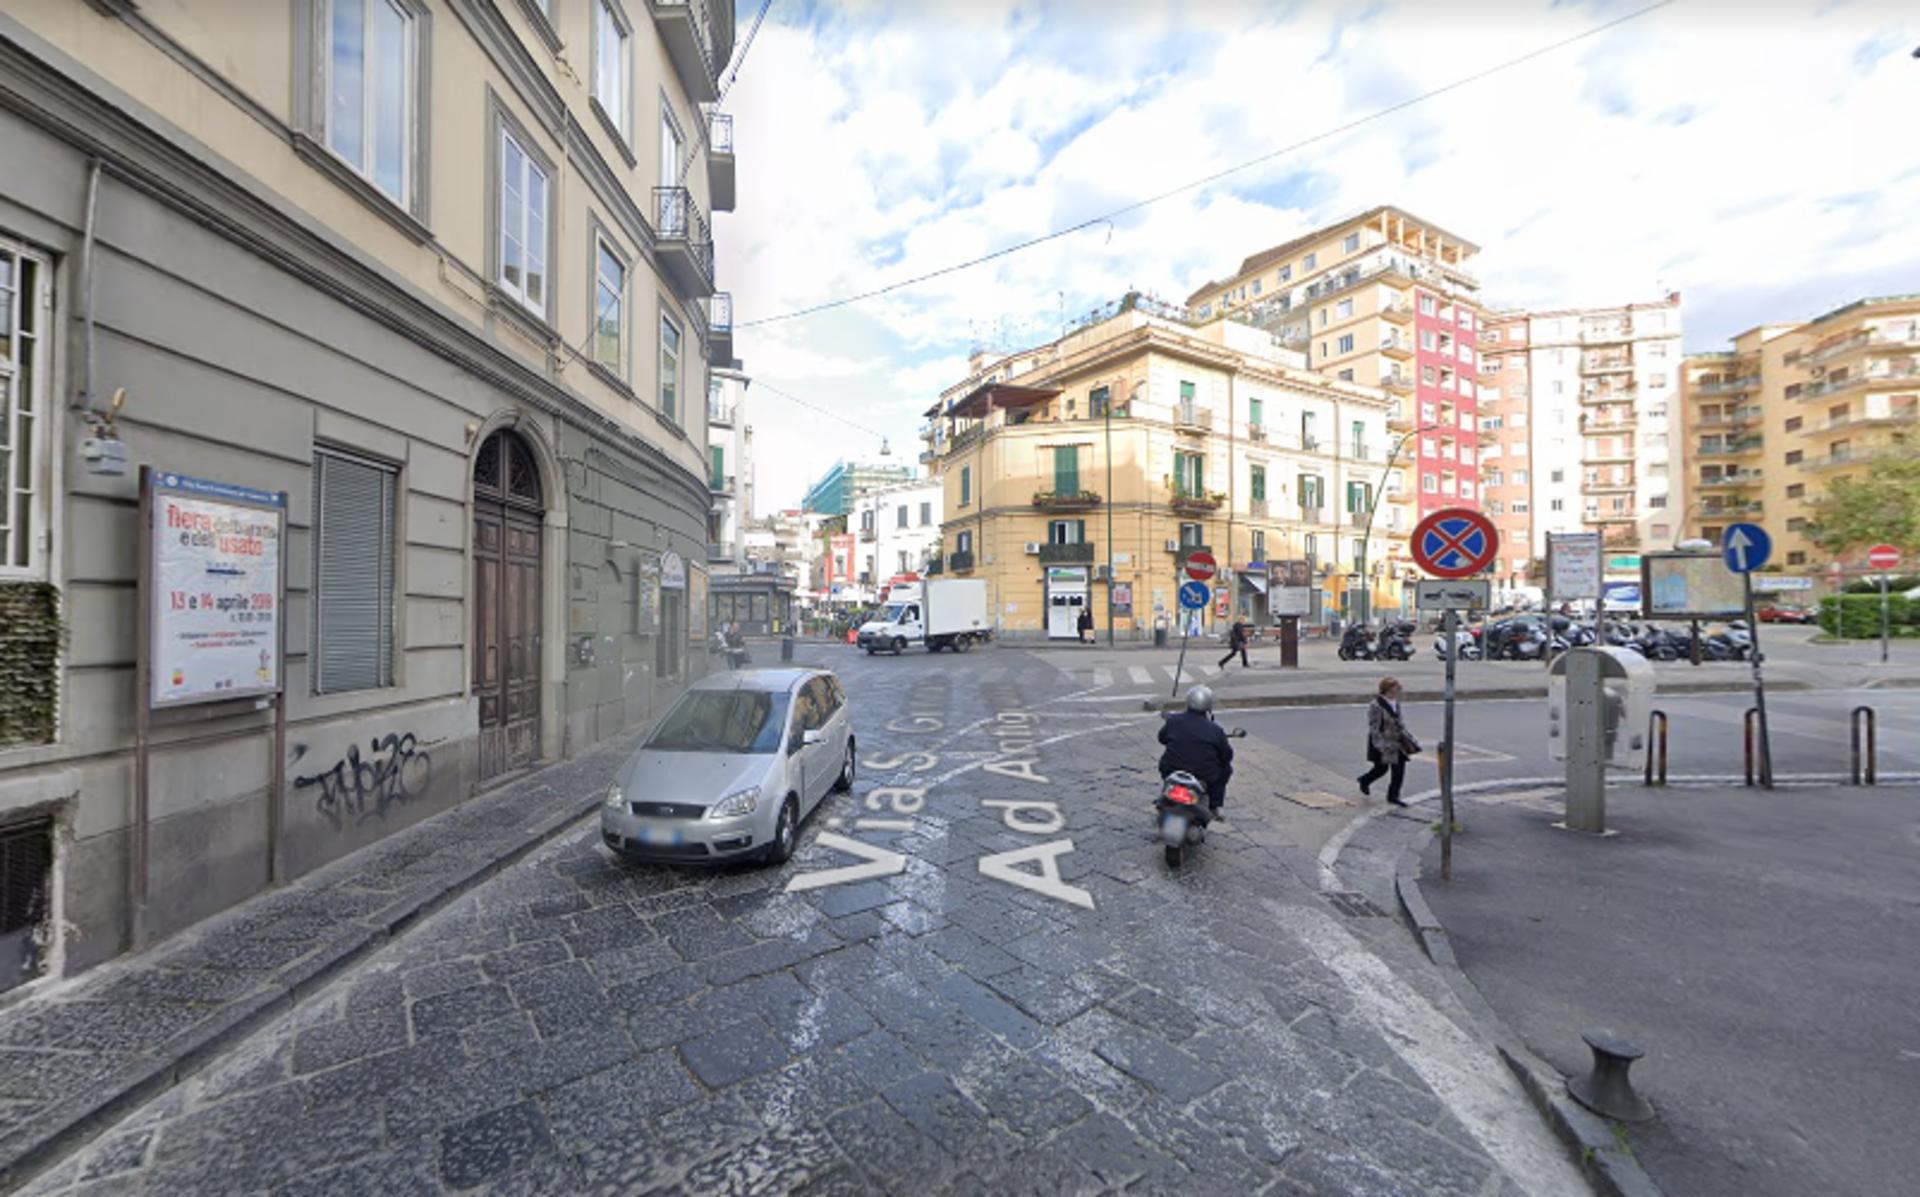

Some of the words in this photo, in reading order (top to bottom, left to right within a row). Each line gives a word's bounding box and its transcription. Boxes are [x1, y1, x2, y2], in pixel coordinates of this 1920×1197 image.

[171, 591, 185, 609] 13
[188, 595, 198, 610] e
[200, 592, 214, 609] 14
[216, 592, 250, 612] aprile
